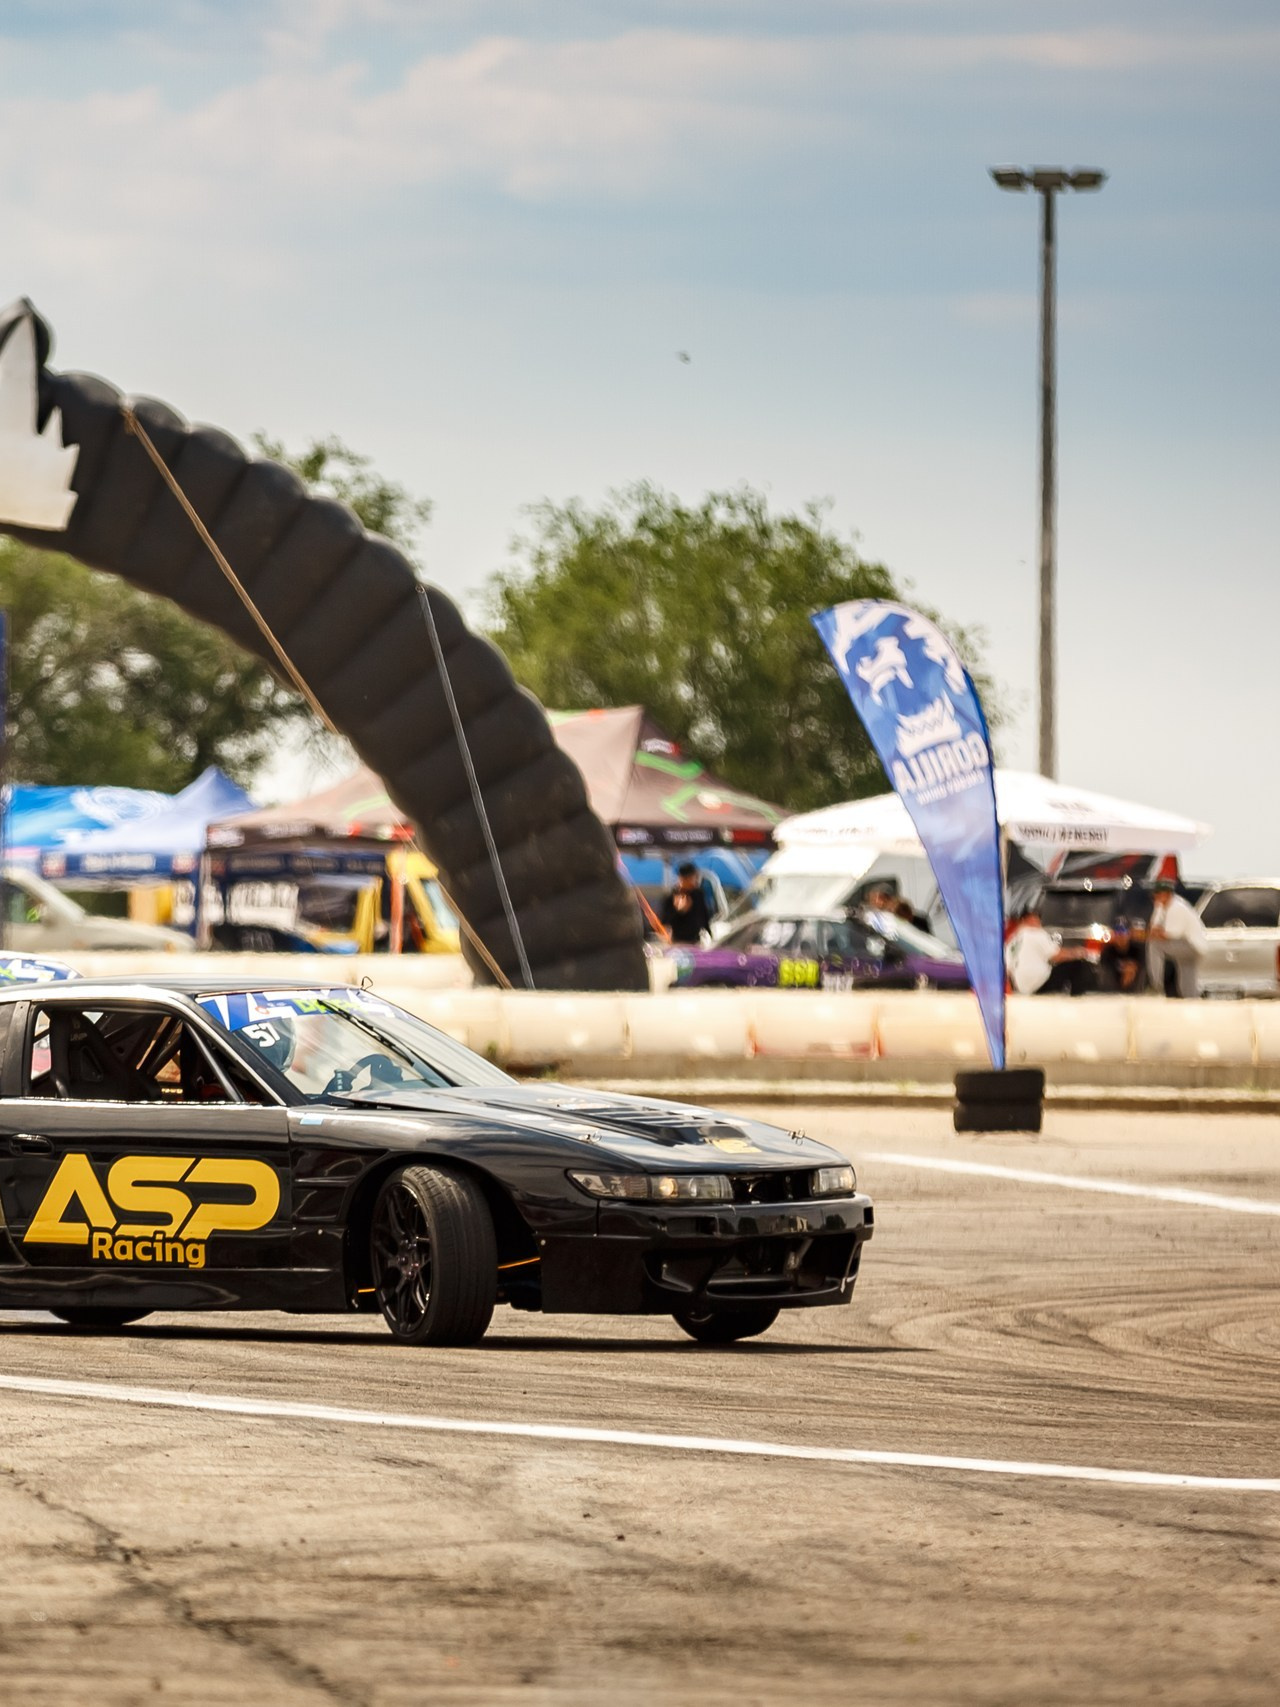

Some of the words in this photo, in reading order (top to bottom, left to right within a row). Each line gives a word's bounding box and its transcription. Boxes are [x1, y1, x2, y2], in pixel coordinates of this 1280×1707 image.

[242, 1022, 281, 1048] 57
[23, 1153, 280, 1246] ASP
[92, 1232, 206, 1268] Racing
